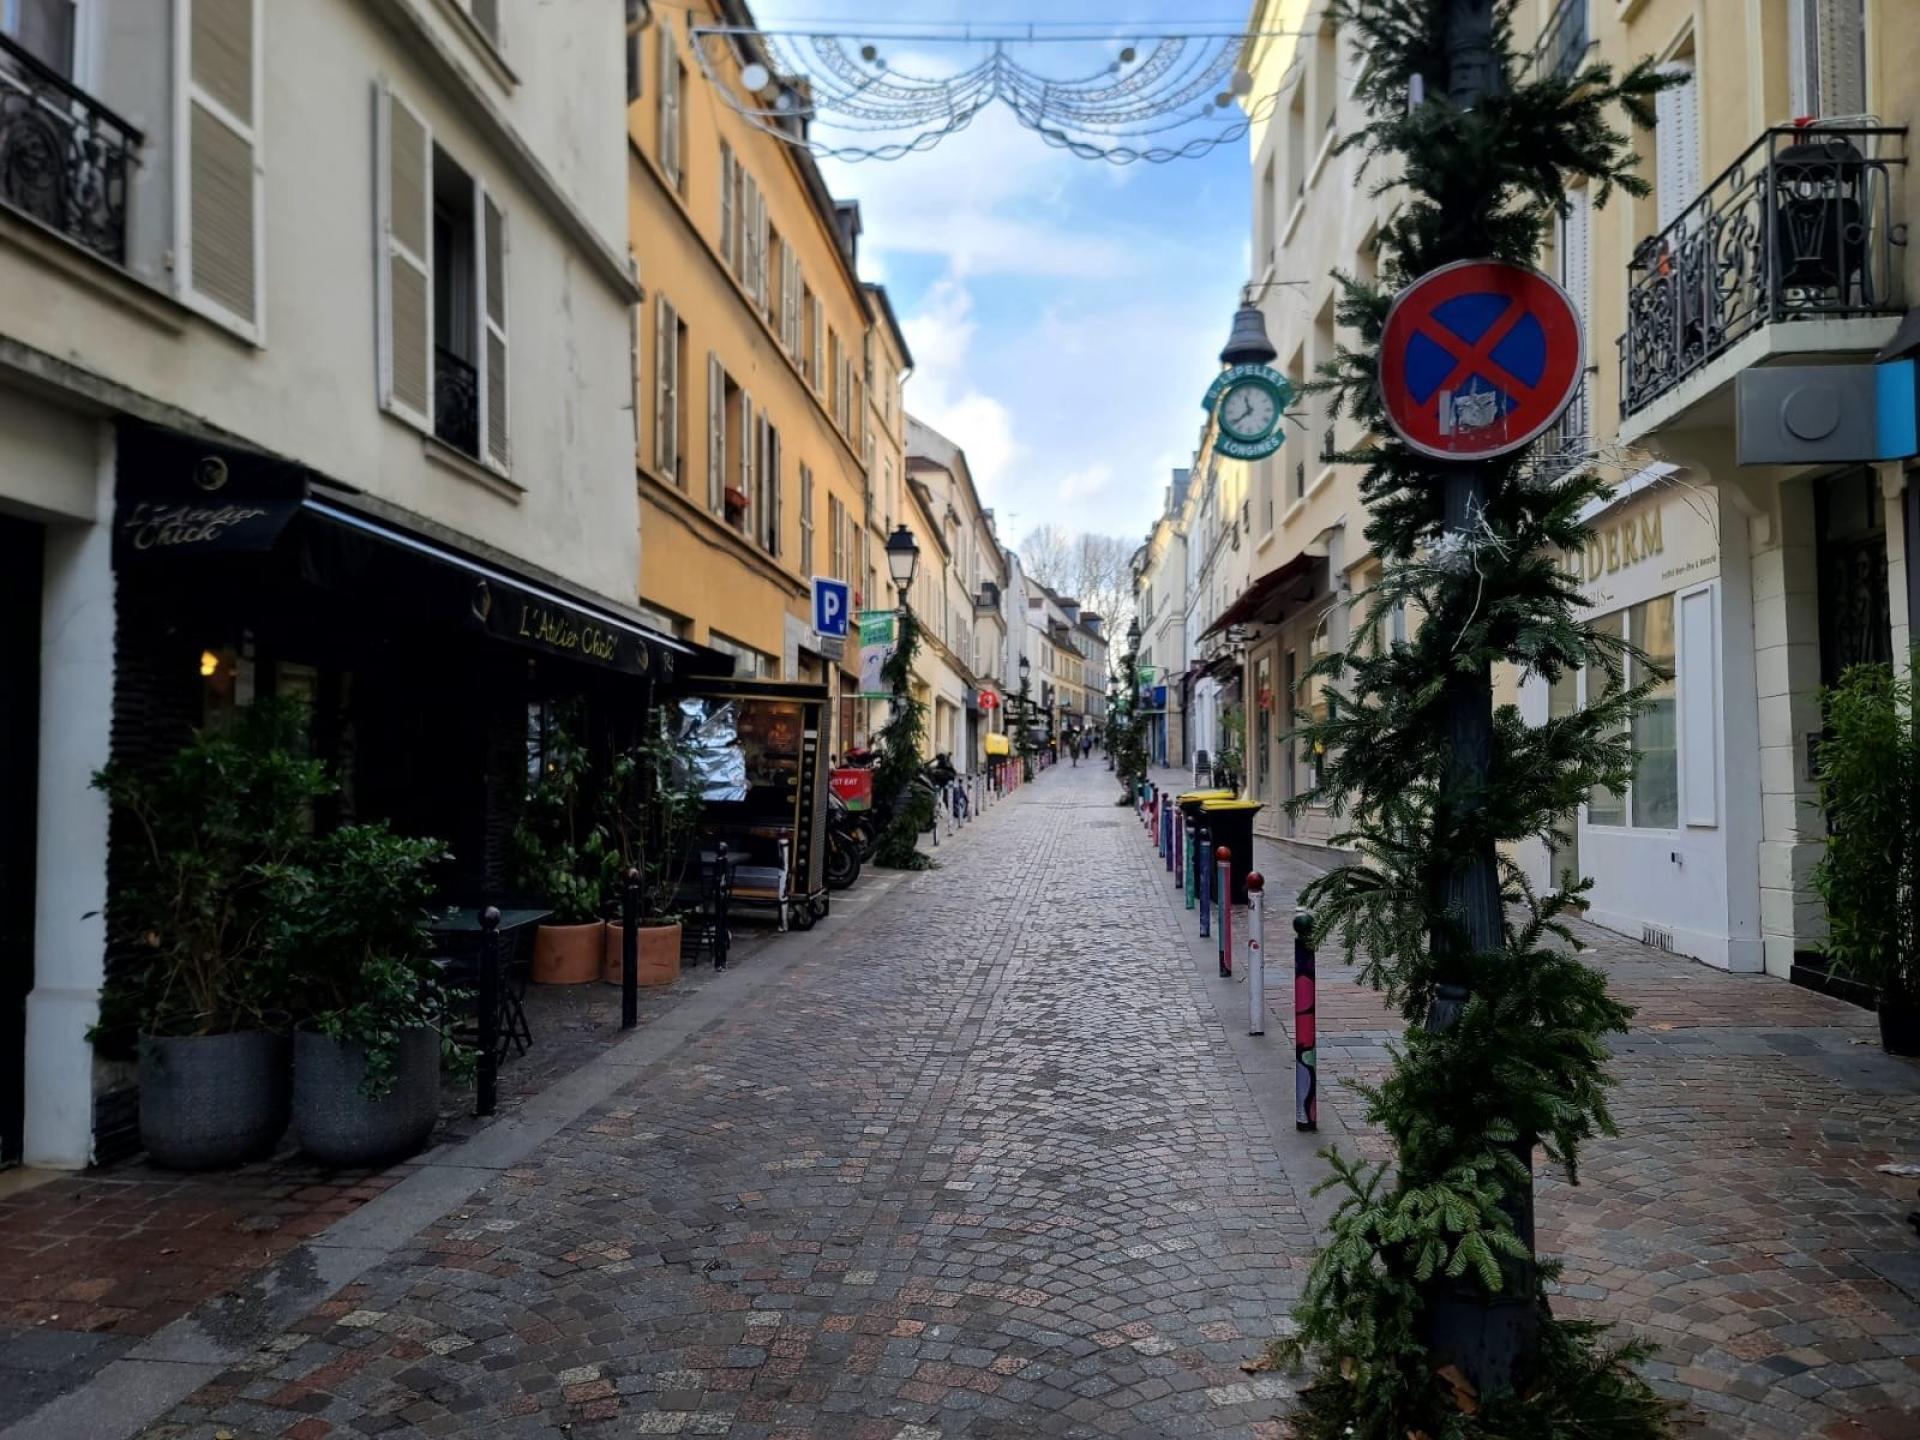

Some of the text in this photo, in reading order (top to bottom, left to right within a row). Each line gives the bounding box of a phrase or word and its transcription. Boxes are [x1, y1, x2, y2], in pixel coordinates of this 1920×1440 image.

[1219, 364, 1287, 387] LEPELLEY
[1222, 436, 1281, 456] LONGINES
[823, 590, 840, 625] P
[517, 605, 578, 649] L'Atelier
